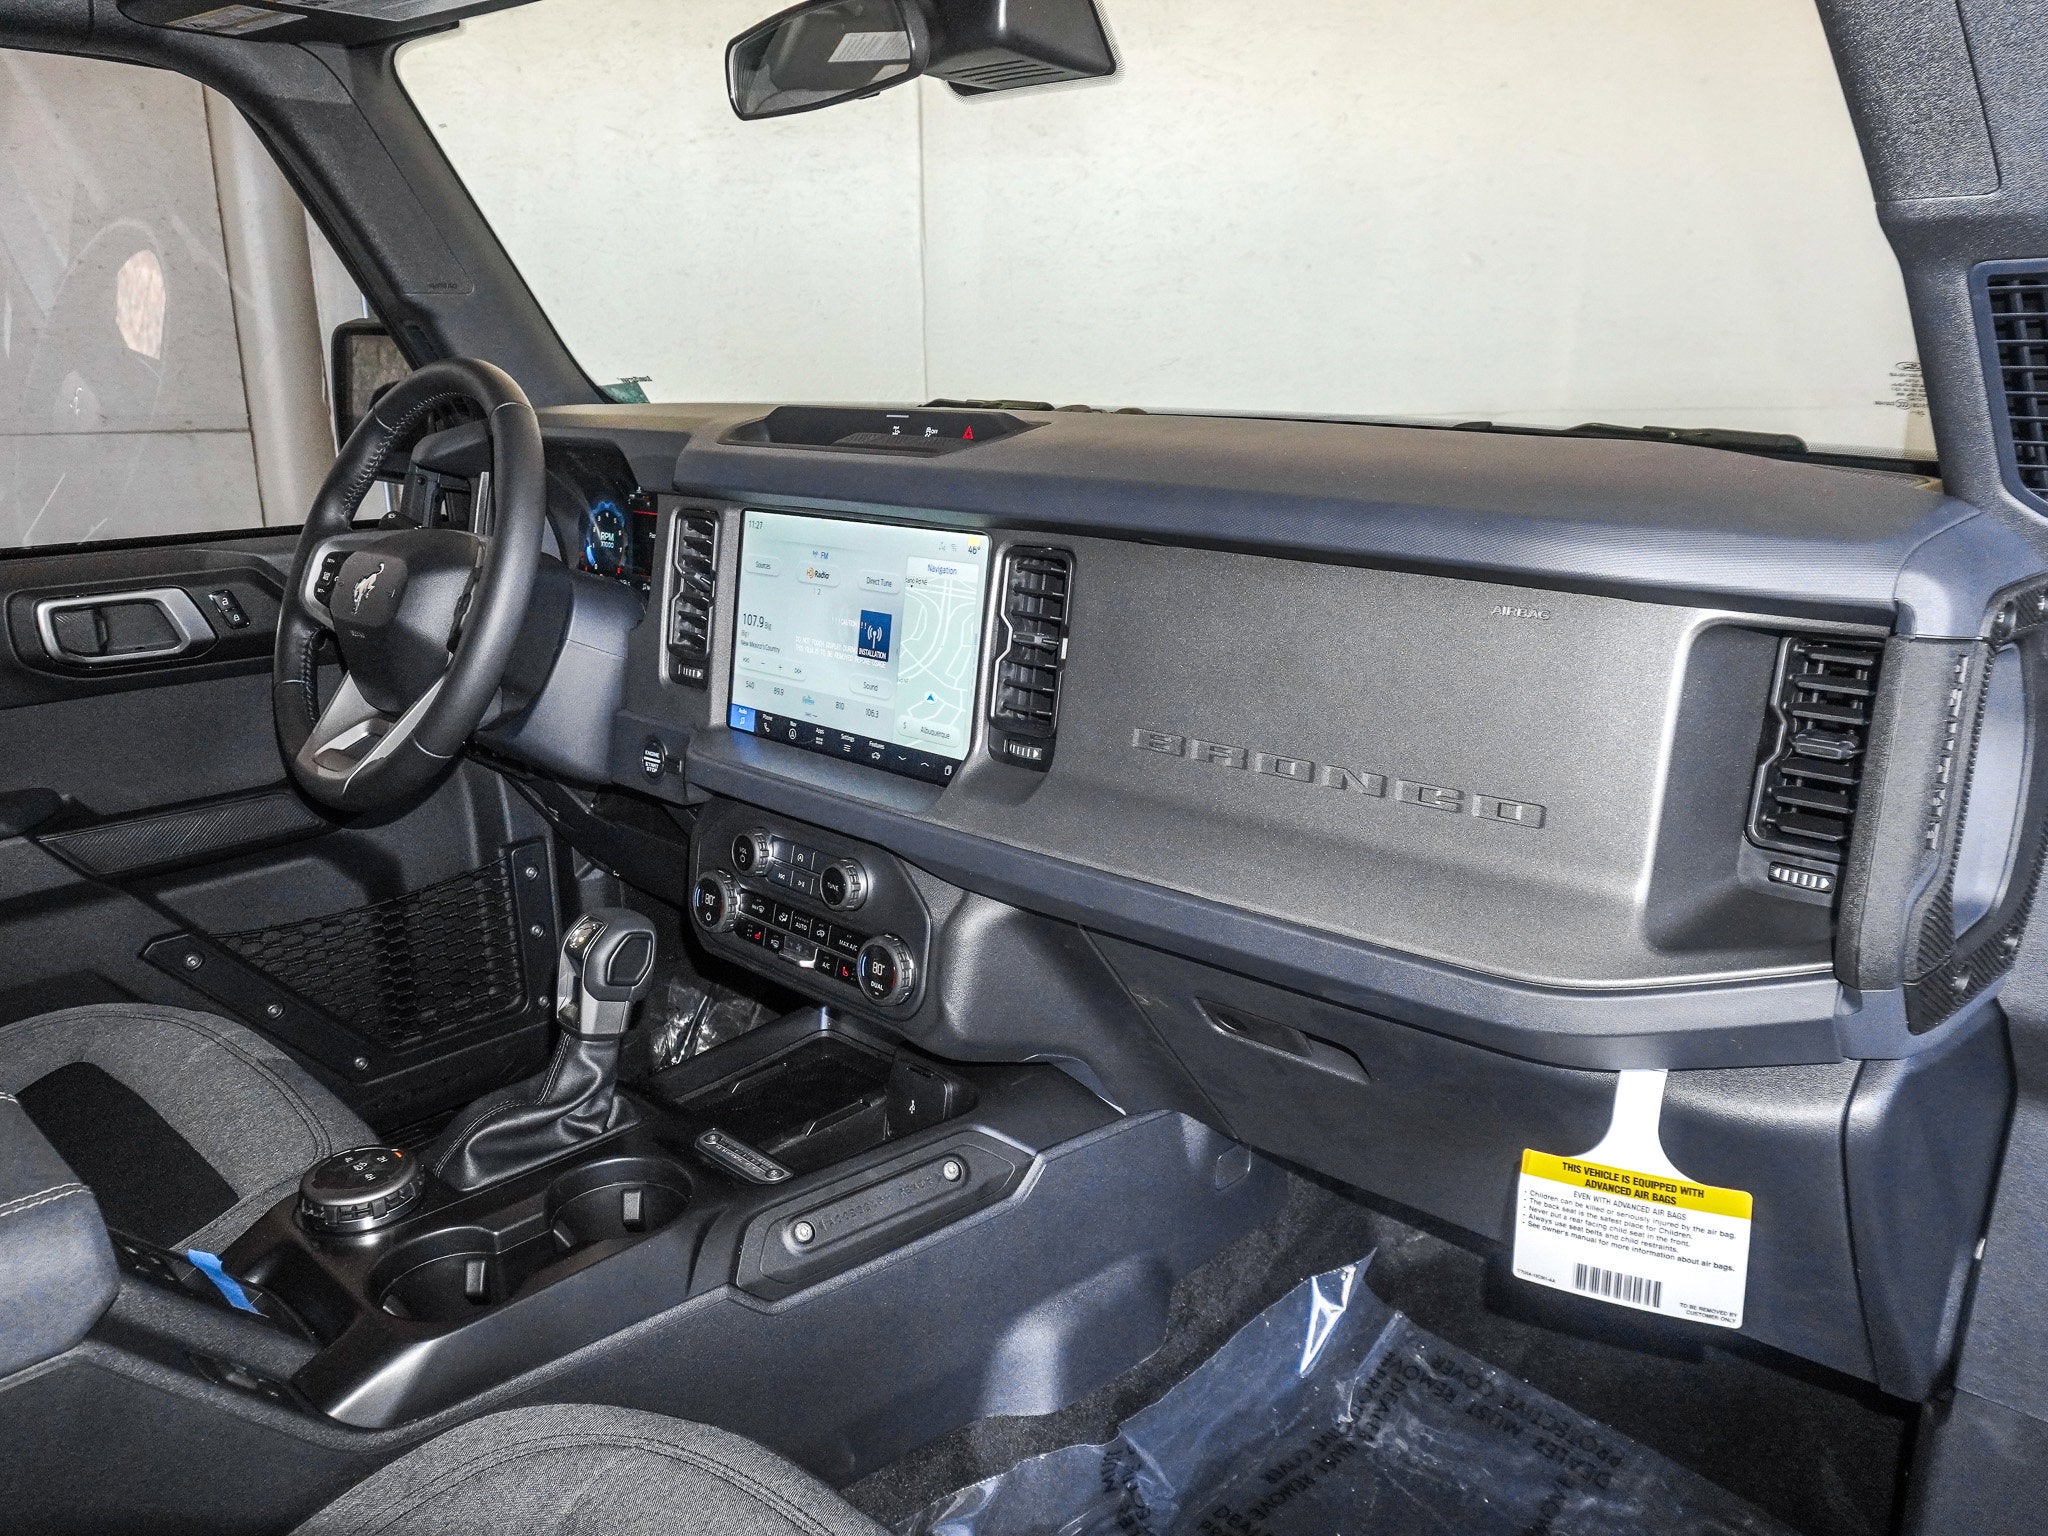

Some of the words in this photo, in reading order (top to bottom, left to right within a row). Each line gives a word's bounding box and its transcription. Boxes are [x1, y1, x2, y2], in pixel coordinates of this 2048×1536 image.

[748, 520, 763, 530] 11:27
[600, 531, 615, 541] RPM
[820, 551, 829, 560] FM
[755, 560, 771, 570] Sources
[927, 563, 958, 576] Navigation
[814, 570, 830, 580] Radio
[866, 576, 880, 586] Direct
[880, 578, 893, 588] Tune
[1491, 605, 1551, 620] AIRBAG
[743, 613, 765, 628] 107.9
[863, 681, 878, 692] Sound
[745, 680, 755, 690] 540
[865, 708, 879, 719] 106.3
[815, 727, 825, 735] Apps
[920, 726, 951, 740] Albuquerque
[840, 733, 855, 743] Settings
[868, 740, 885, 750] Features
[1131, 727, 1547, 829] BRONCO
[827, 881, 839, 892] TUNE
[795, 922, 808, 931] AUTO
[838, 939, 849, 947] MAX
[849, 943, 858, 952] A/C
[822, 961, 830, 970] A/C
[870, 980, 884, 991] DUAL
[1562, 1161, 1582, 1174] THIS
[1583, 1166, 1620, 1182] VEHICLE
[1621, 1174, 1631, 1185] IS
[1633, 1177, 1678, 1194] EQUIPPED
[1680, 1186, 1705, 1199] WITH
[1584, 1179, 1632, 1197] ADVANCED
[1634, 1189, 1650, 1200] AIR
[1652, 1192, 1677, 1205] BAGS
[1573, 1190, 1591, 1201] EVEN
[1593, 1194, 1611, 1205] WITH
[1613, 1198, 1651, 1214] ADVANCED
[1652, 1207, 1665, 1217] AIR
[1667, 1210, 1687, 1221] BAGS
[1529, 1189, 1559, 1202] Children
[1560, 1196, 1573, 1204] can
[1575, 1200, 1584, 1209] be
[1585, 1202, 1605, 1213] killed
[1616, 1210, 1650, 1224] seriously
[1652, 1218, 1679, 1229] injured
[1681, 1223, 1690, 1232] by
[1693, 1225, 1705, 1234] the
[1707, 1228, 1718, 1236] air
[1719, 1230, 1736, 1240] bag.
[1529, 1197, 1542, 1206] The
[1543, 1200, 1560, 1210] back
[1562, 1205, 1577, 1215] seat
[1586, 1211, 1598, 1220] the
[1600, 1213, 1622, 1222] safest
[1624, 1219, 1644, 1230] place
[1646, 1224, 1656, 1232] for
[1658, 1225, 1693, 1239] Children.
[1529, 1205, 1548, 1215] Never
[1550, 1210, 1562, 1219] put
[1569, 1215, 1583, 1224] rear
[1585, 1219, 1608, 1231] facing
[1609, 1224, 1628, 1234] child
[1629, 1229, 1645, 1239] seat
[1647, 1232, 1654, 1240] in
[1656, 1234, 1668, 1243] the
[1670, 1238, 1691, 1247] front.
[1528, 1213, 1553, 1225] Always
[1554, 1220, 1567, 1229] use
[1569, 1224, 1584, 1233] seat
[1585, 1226, 1603, 1237] belts
[1604, 1231, 1619, 1241] and
[1620, 1235, 1639, 1245] child
[1640, 1240, 1679, 1253] restraints.
[1527, 1220, 1541, 1230] See
[1542, 1226, 1569, 1237] owner's
[1570, 1232, 1598, 1243] manual
[1599, 1238, 1609, 1246] for
[1610, 1242, 1630, 1252] more
[1631, 1246, 1675, 1261] information
[1677, 1256, 1700, 1266] about
[1713, 1262, 1735, 1272] bags.
[1686, 1310, 1719, 1320] CUSTOMER
[1699, 1306, 1728, 1317] REMOVED
